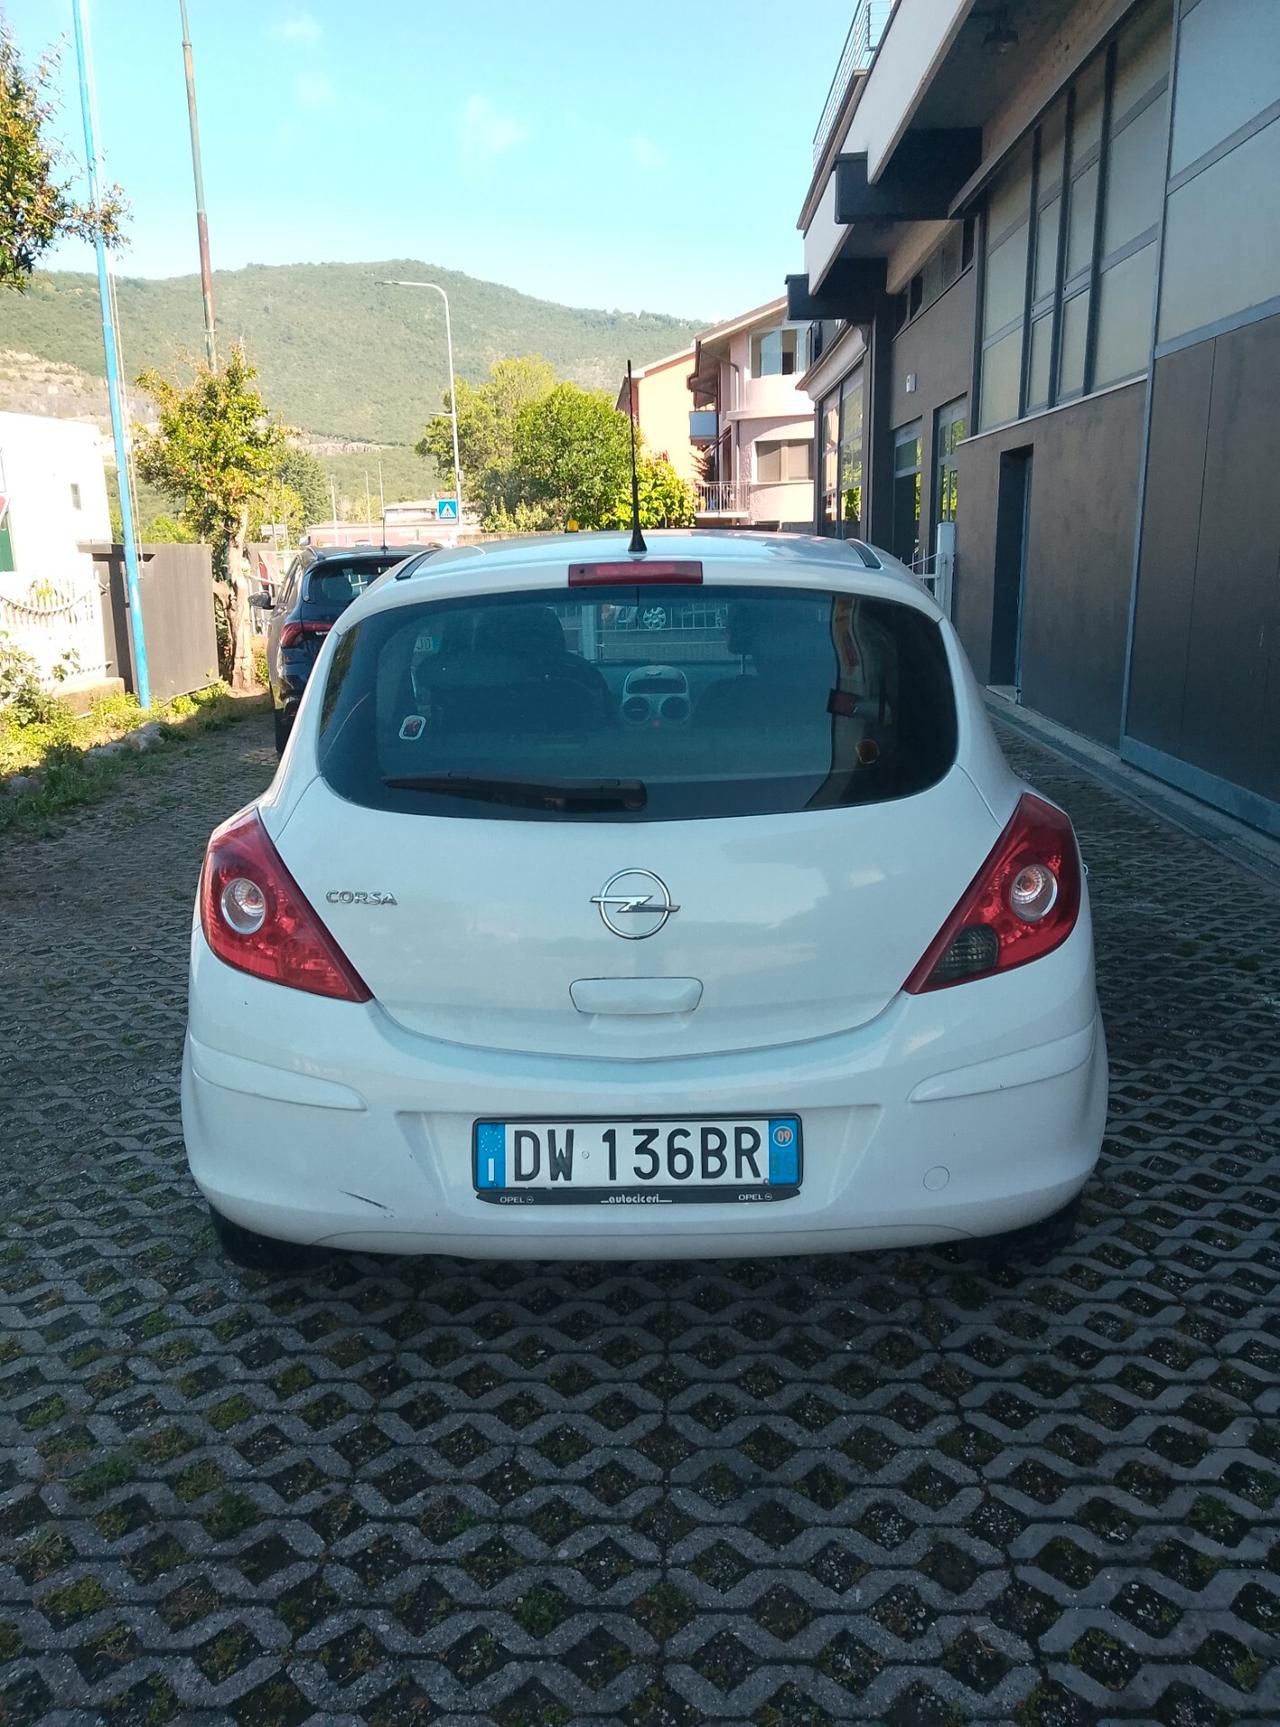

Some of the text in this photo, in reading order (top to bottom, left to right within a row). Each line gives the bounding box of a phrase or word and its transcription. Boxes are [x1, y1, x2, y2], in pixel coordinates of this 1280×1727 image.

[326, 891, 398, 905] CORSA
[777, 1130, 791, 1143] 09
[514, 1129, 574, 1181] DW
[602, 1127, 761, 1180] 136BR
[500, 1196, 525, 1204] OPEL
[738, 1193, 763, 1201] OPEL
